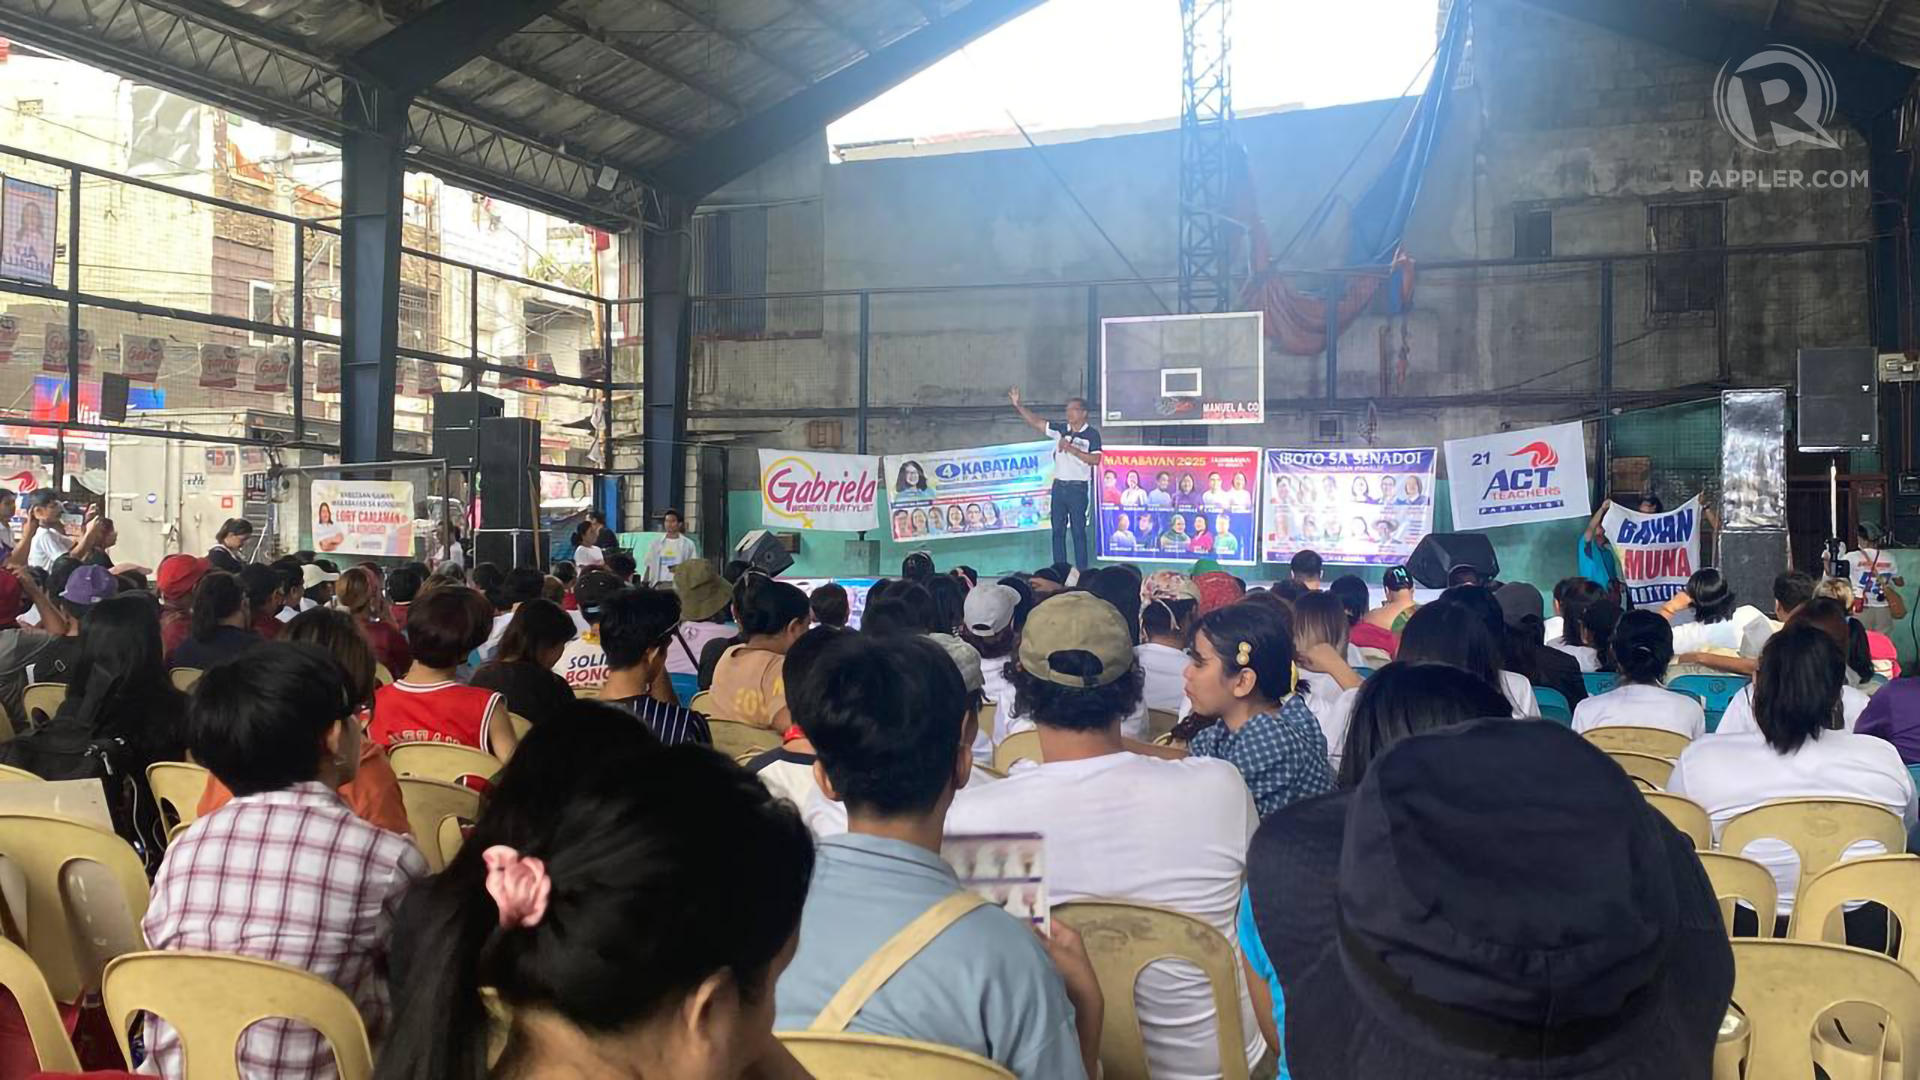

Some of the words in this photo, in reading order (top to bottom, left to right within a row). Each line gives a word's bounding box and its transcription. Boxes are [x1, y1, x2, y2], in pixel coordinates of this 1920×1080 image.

[1202, 402, 1236, 412] MANUEL
[961, 455, 1039, 475] KABATAAN
[1103, 455, 1176, 467] MAKABAYAN
[1176, 455, 1207, 467] 2025
[1328, 452, 1348, 465] SA
[1472, 451, 1491, 466] 21
[942, 464, 954, 479] 4
[767, 467, 877, 512] Gabriela
[1482, 466, 1556, 500] ACT
[1491, 487, 1561, 501] TEACHERS
[1480, 501, 1562, 514] PARTYLIST
[1616, 508, 1693, 545] BAYAN
[1624, 546, 1691, 580] MUNA
[1631, 584, 1687, 603] ARTYLI
[567, 653, 606, 670] SOLI
